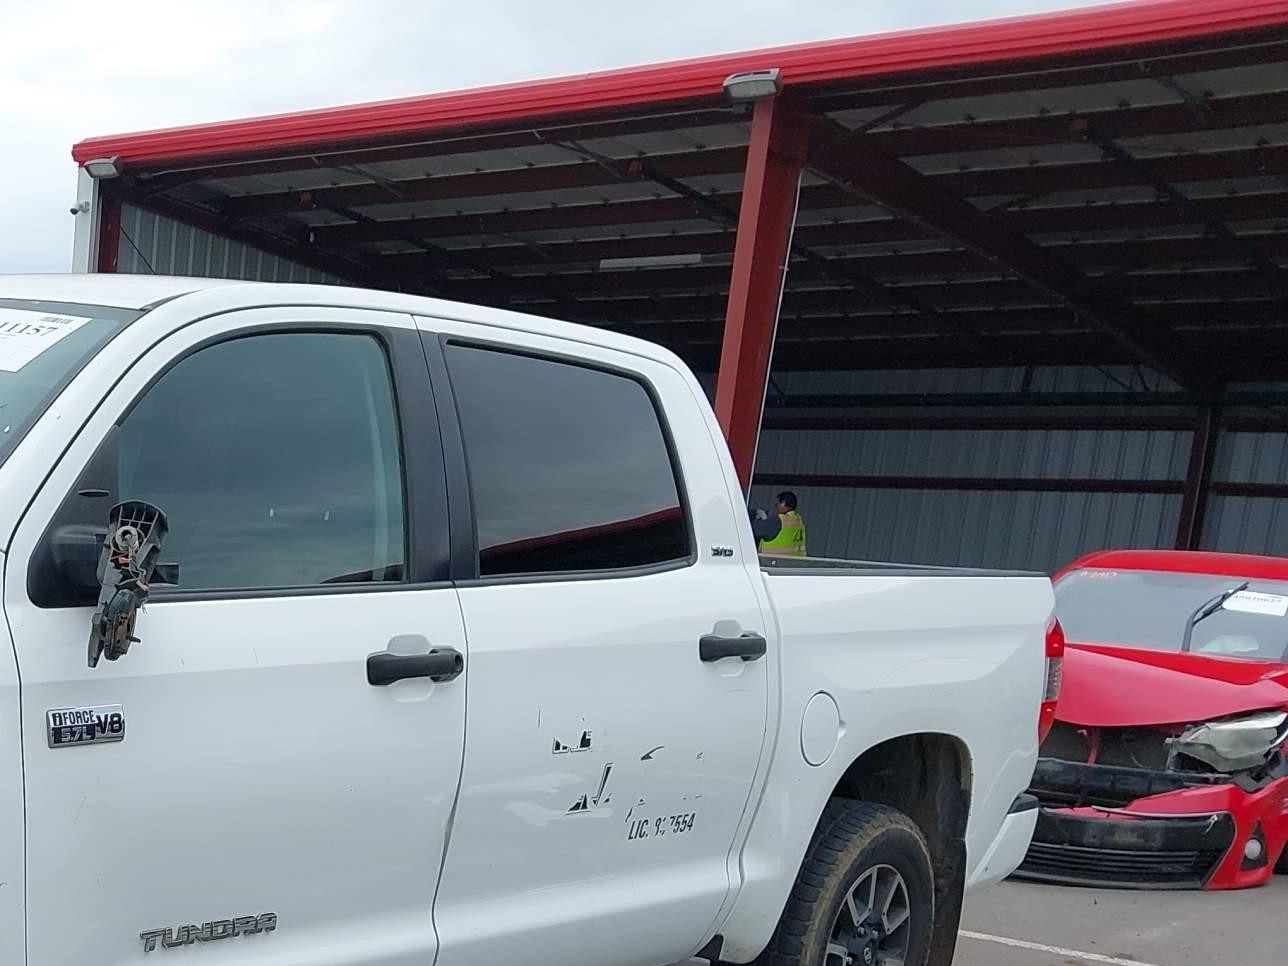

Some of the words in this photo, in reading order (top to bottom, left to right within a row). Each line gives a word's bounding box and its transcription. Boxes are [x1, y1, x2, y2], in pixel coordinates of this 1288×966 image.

[95, 712, 123, 735] V8
[628, 819, 649, 840] LIC.
[139, 911, 278, 953] TUNDRA
